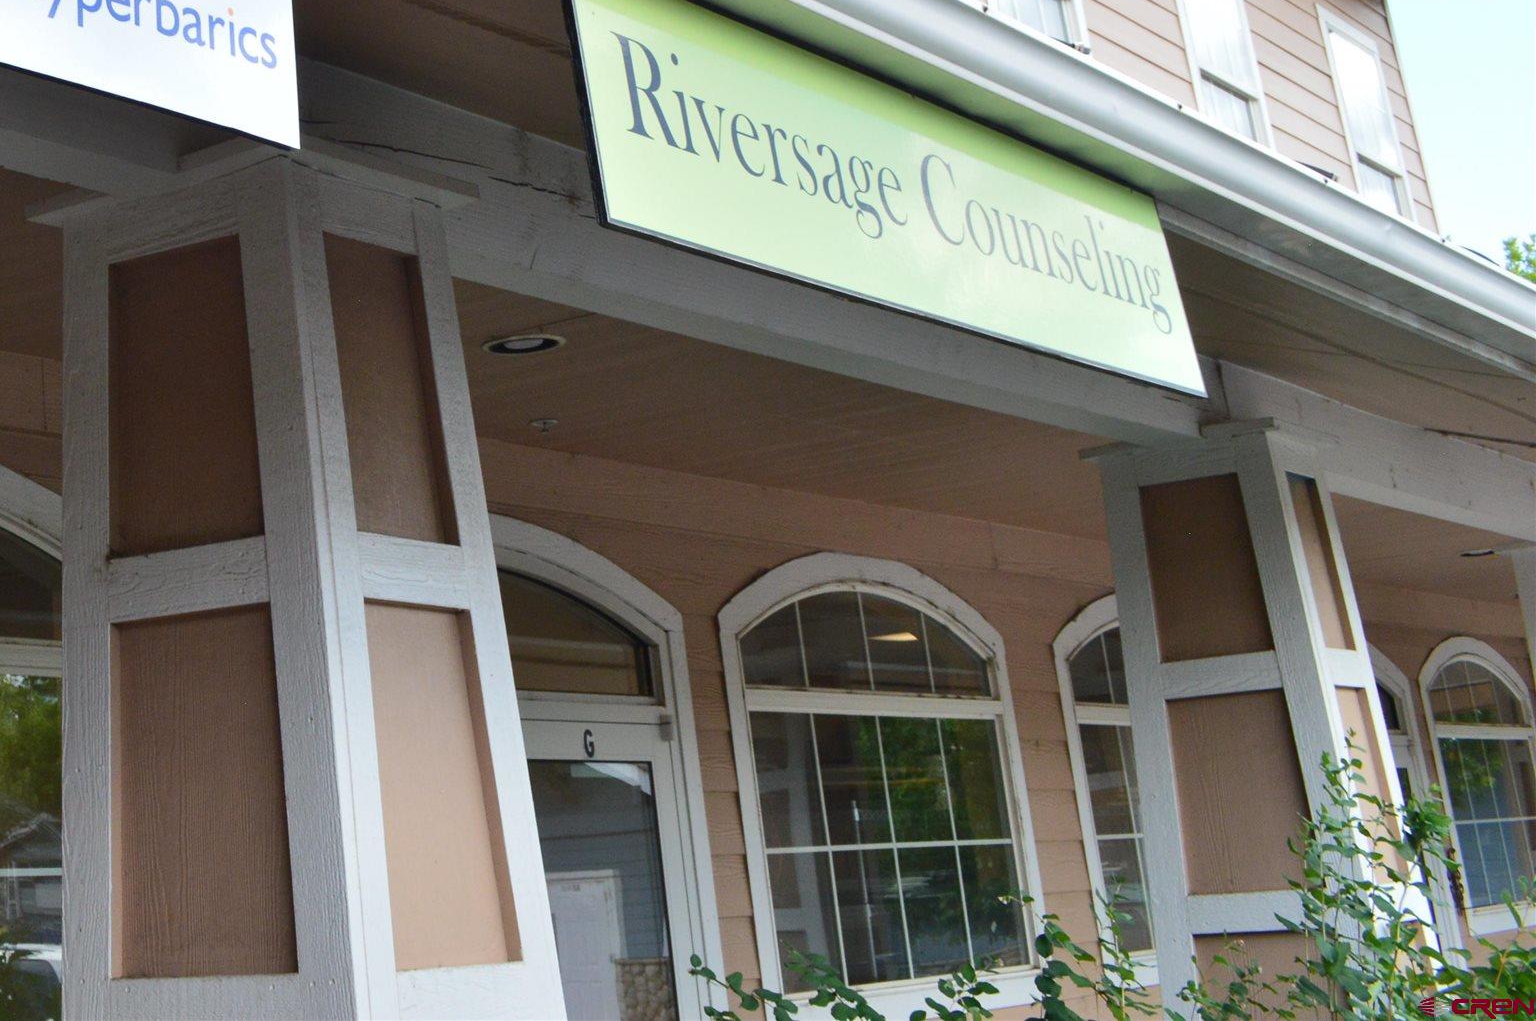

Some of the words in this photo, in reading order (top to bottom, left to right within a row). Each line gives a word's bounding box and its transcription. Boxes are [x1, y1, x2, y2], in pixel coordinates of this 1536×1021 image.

[609, 30, 908, 239] Riversage
[921, 153, 1172, 334] Counseling
[583, 729, 595, 758] G
